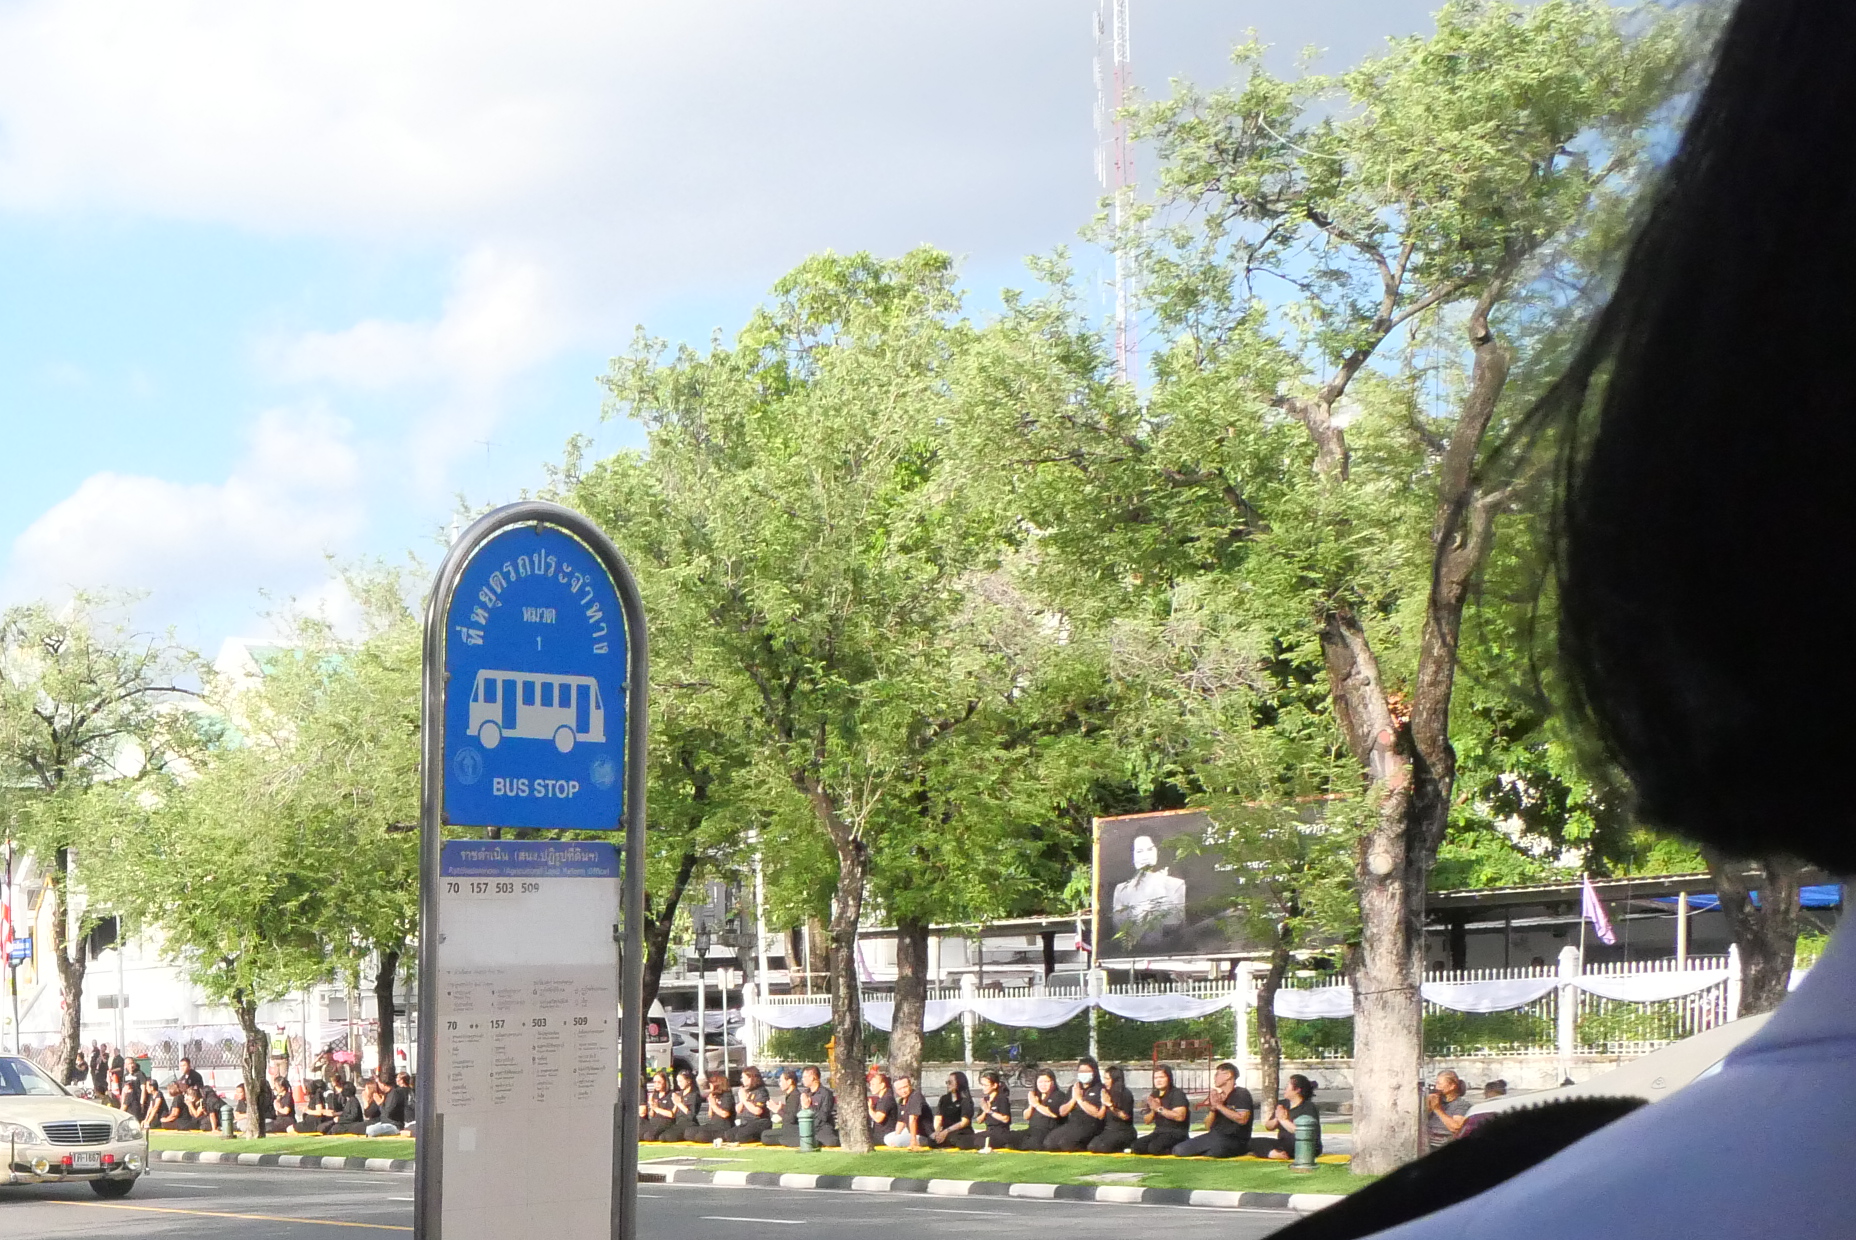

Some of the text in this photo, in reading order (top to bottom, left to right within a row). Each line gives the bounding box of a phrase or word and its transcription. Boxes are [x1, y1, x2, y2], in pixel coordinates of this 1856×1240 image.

[456, 549, 608, 654] ที่หยุดรถประจำทาง
[522, 606, 556, 624] หมวด
[493, 777, 580, 798] BUS STOP
[447, 882, 540, 893] 70 157 503 509
[447, 1017, 588, 1030] 70 157 503 509
